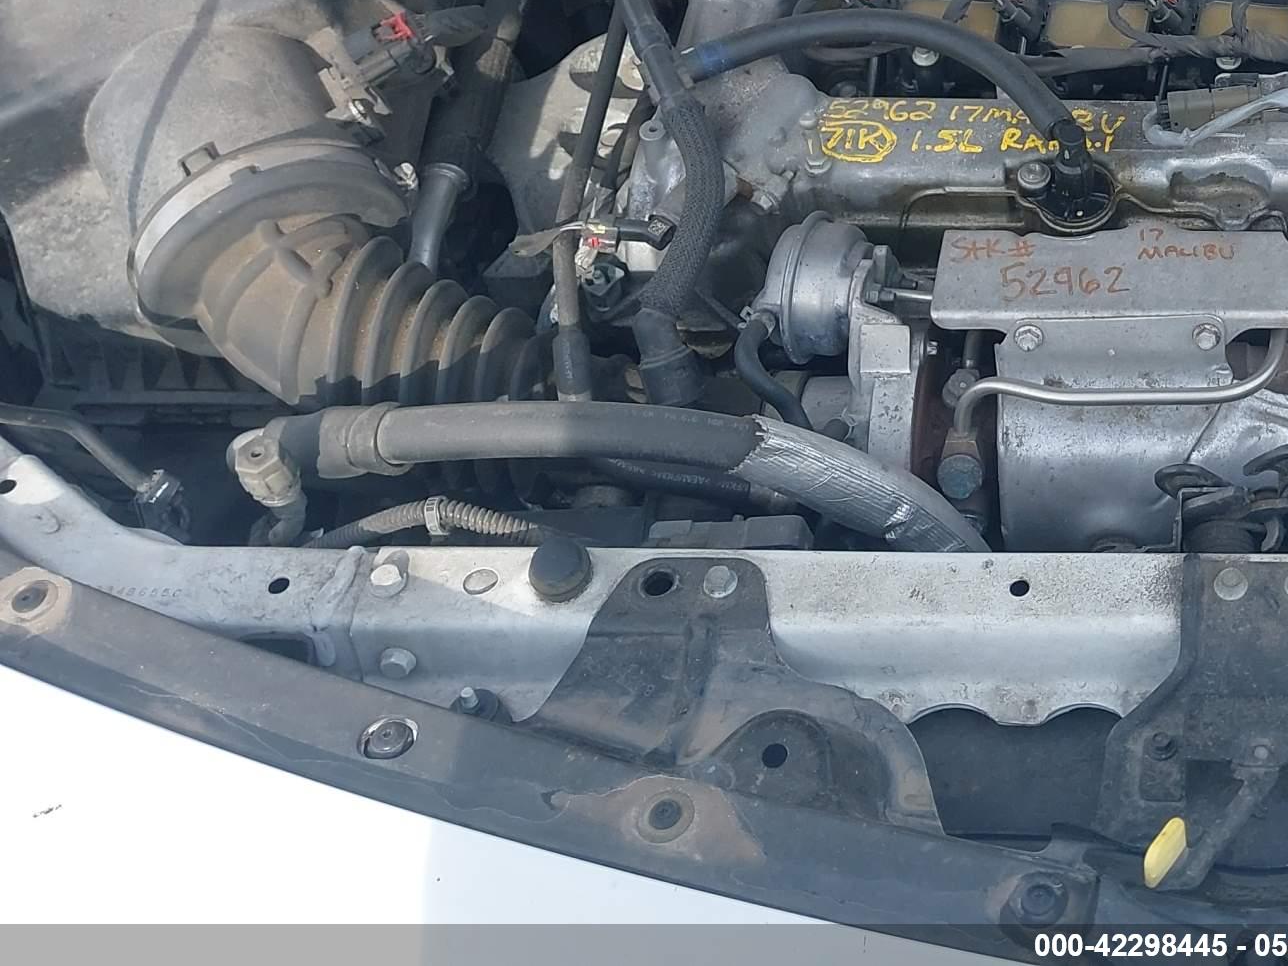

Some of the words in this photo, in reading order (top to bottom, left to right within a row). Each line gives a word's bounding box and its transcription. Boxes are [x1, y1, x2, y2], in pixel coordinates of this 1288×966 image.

[822, 98, 937, 121] 52962
[1138, 227, 1164, 241] 17
[1137, 243, 1235, 261] MALIBU
[1000, 261, 1130, 303] 52962
